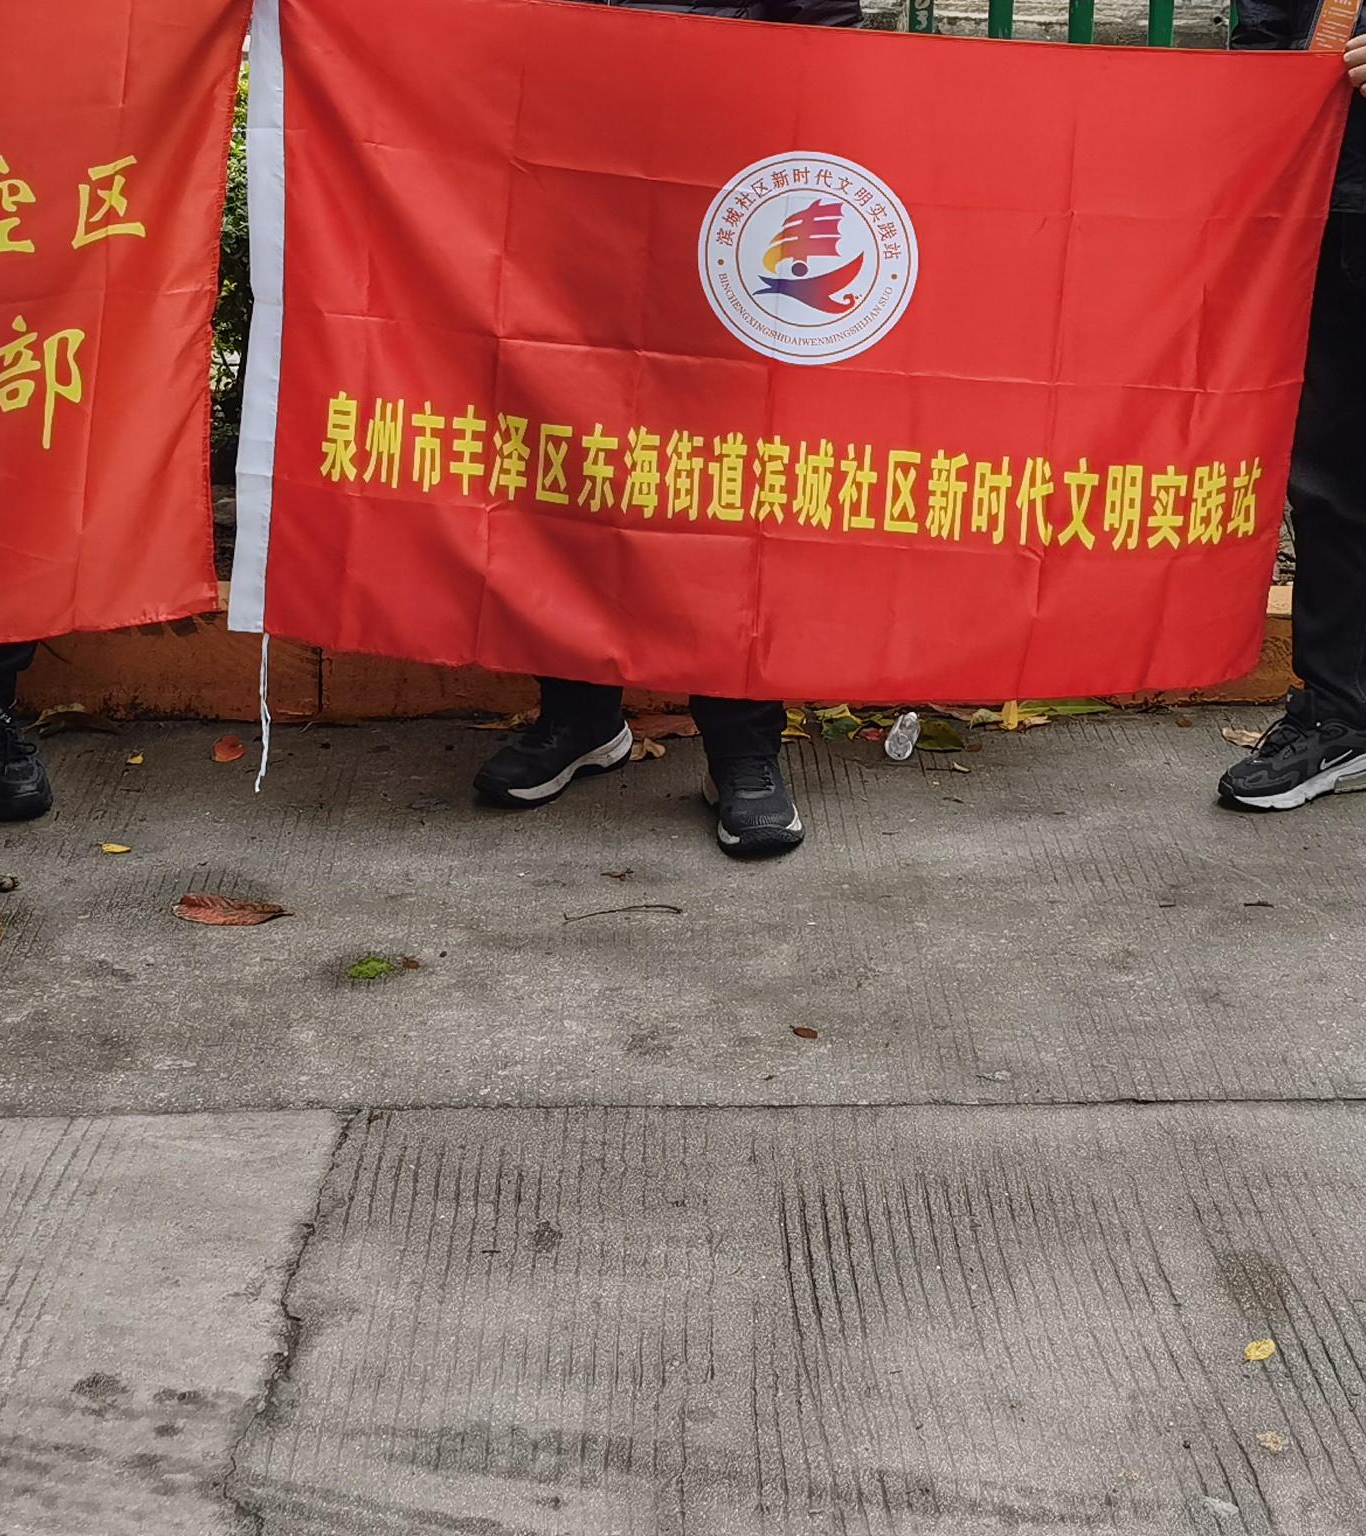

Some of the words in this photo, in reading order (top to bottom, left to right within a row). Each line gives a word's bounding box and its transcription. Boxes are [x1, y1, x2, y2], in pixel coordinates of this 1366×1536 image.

[716, 166, 902, 261] 滨城社区新时代文明实践站
[319, 390, 1262, 552] 泉州市丰泽区东海街道滨城社区新时代文明实践站
